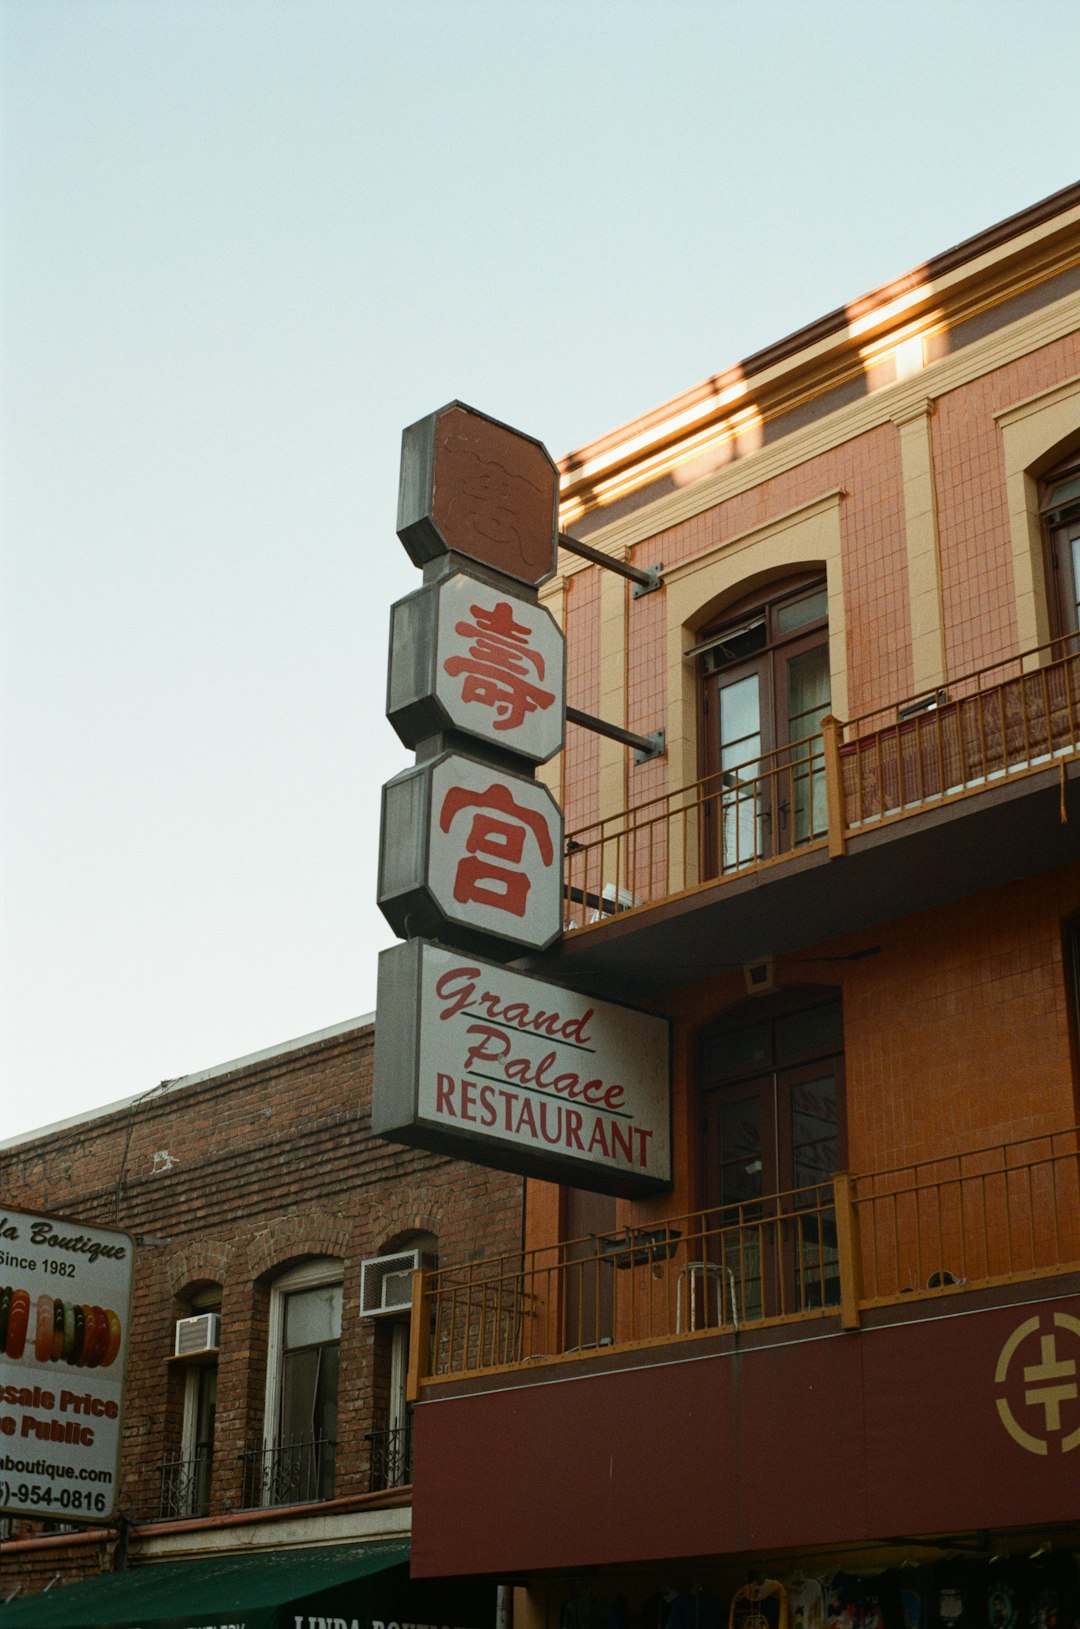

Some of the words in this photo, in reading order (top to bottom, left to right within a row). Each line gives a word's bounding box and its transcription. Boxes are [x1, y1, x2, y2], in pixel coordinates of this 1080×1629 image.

[436, 967, 594, 1043] Grand
[464, 1024, 626, 1110] Palace
[436, 1072, 653, 1168] RESTAURANT
[30, 1222, 127, 1263] Boutique
[42, 1259, 76, 1278] 1982
[59, 1390, 119, 1419] Price
[21, 1415, 95, 1446] Public
[0, 1480, 106, 1512] )-954-0816
